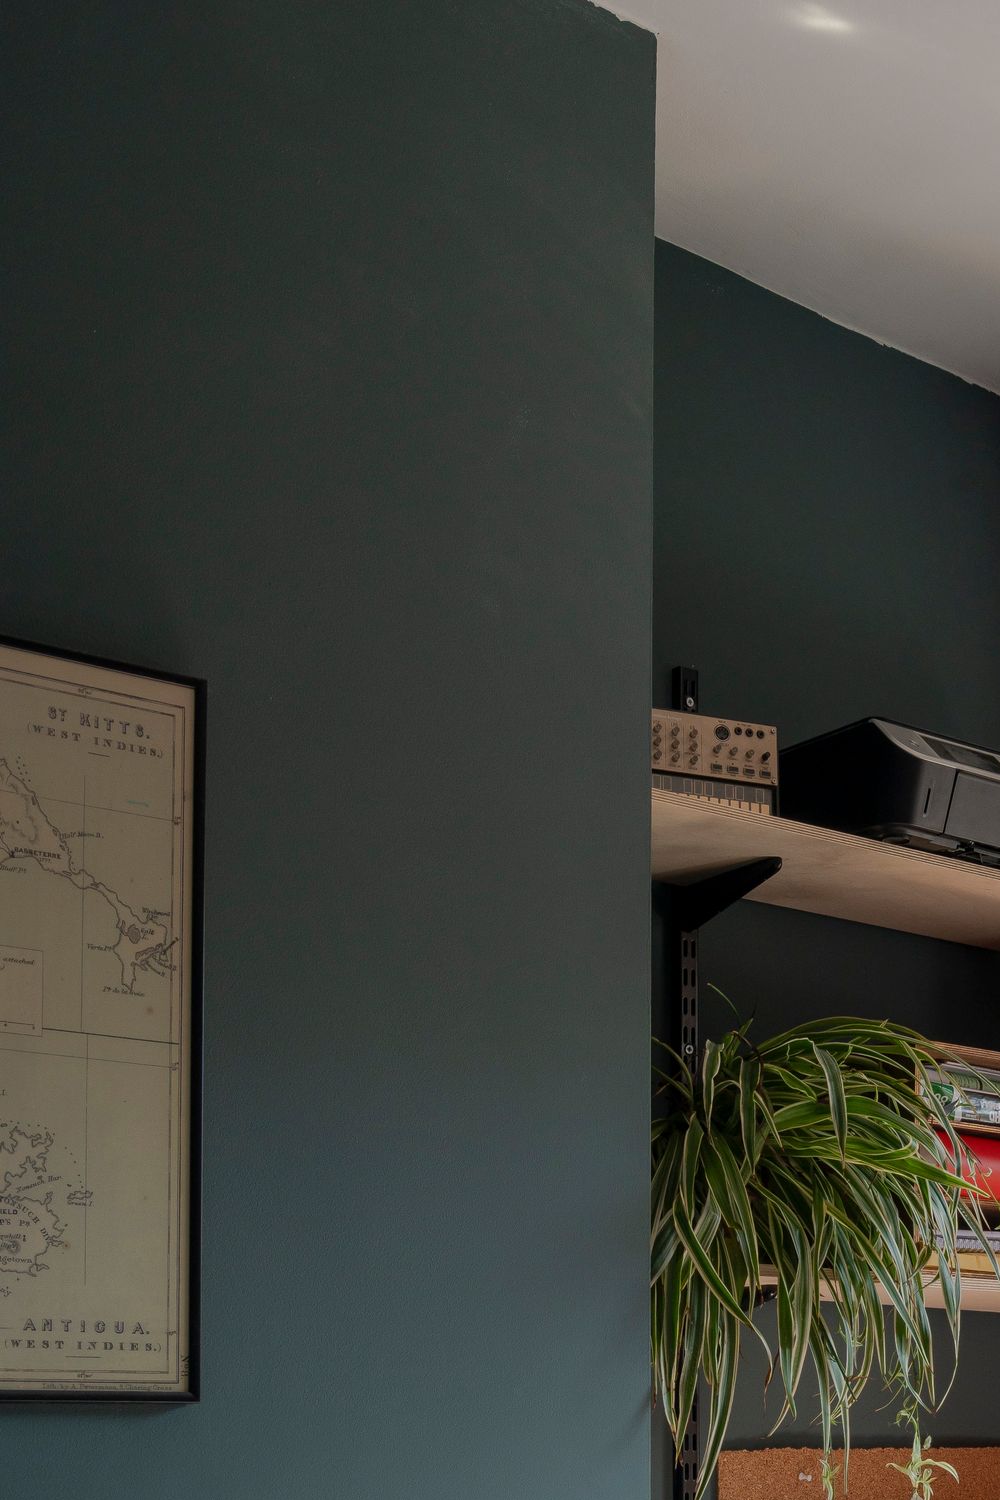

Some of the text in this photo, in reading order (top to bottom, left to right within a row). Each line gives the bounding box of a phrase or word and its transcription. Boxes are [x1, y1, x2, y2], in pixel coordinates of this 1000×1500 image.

[47, 705, 150, 740] ST KITTS.
[27, 722, 81, 742] (WEST
[23, 1318, 151, 1335] ANTIGUA.
[4, 1339, 162, 1352] (WEST INDIES.)
